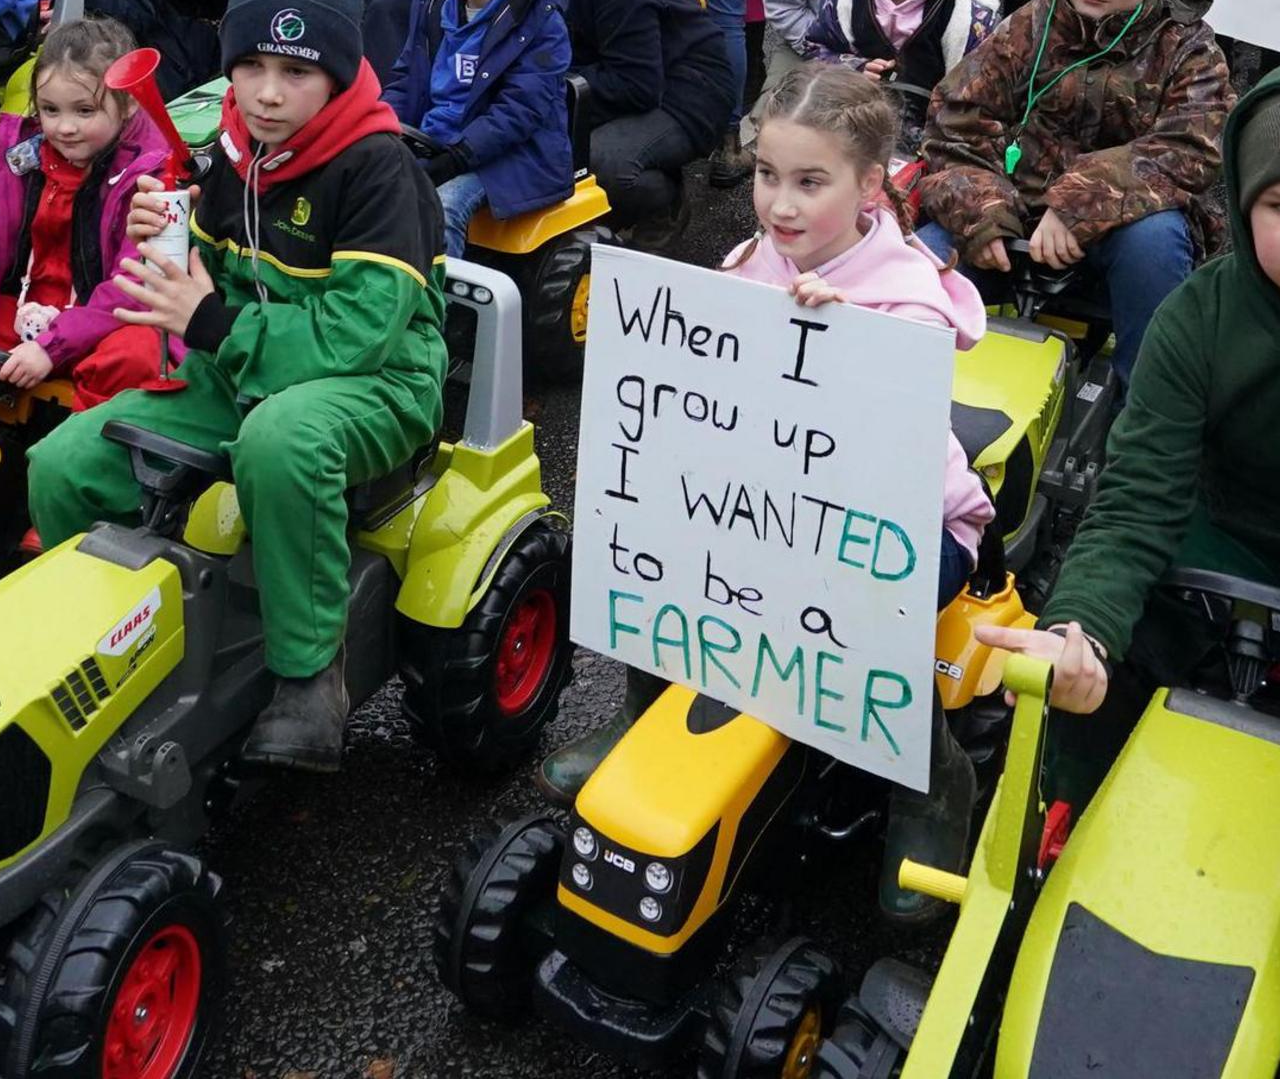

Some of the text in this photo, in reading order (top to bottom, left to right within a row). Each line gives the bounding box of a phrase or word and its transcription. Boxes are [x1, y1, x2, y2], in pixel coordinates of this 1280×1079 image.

[257, 42, 320, 61] GRASSMEN
[614, 277, 829, 387] When I
[616, 374, 835, 474] grow up
[605, 443, 917, 582] I WANTED
[110, 605, 150, 648] CLAAS
[608, 523, 848, 649] to be a
[608, 589, 913, 757] FARMER
[935, 660, 963, 680] CB
[604, 850, 636, 873] JCB
